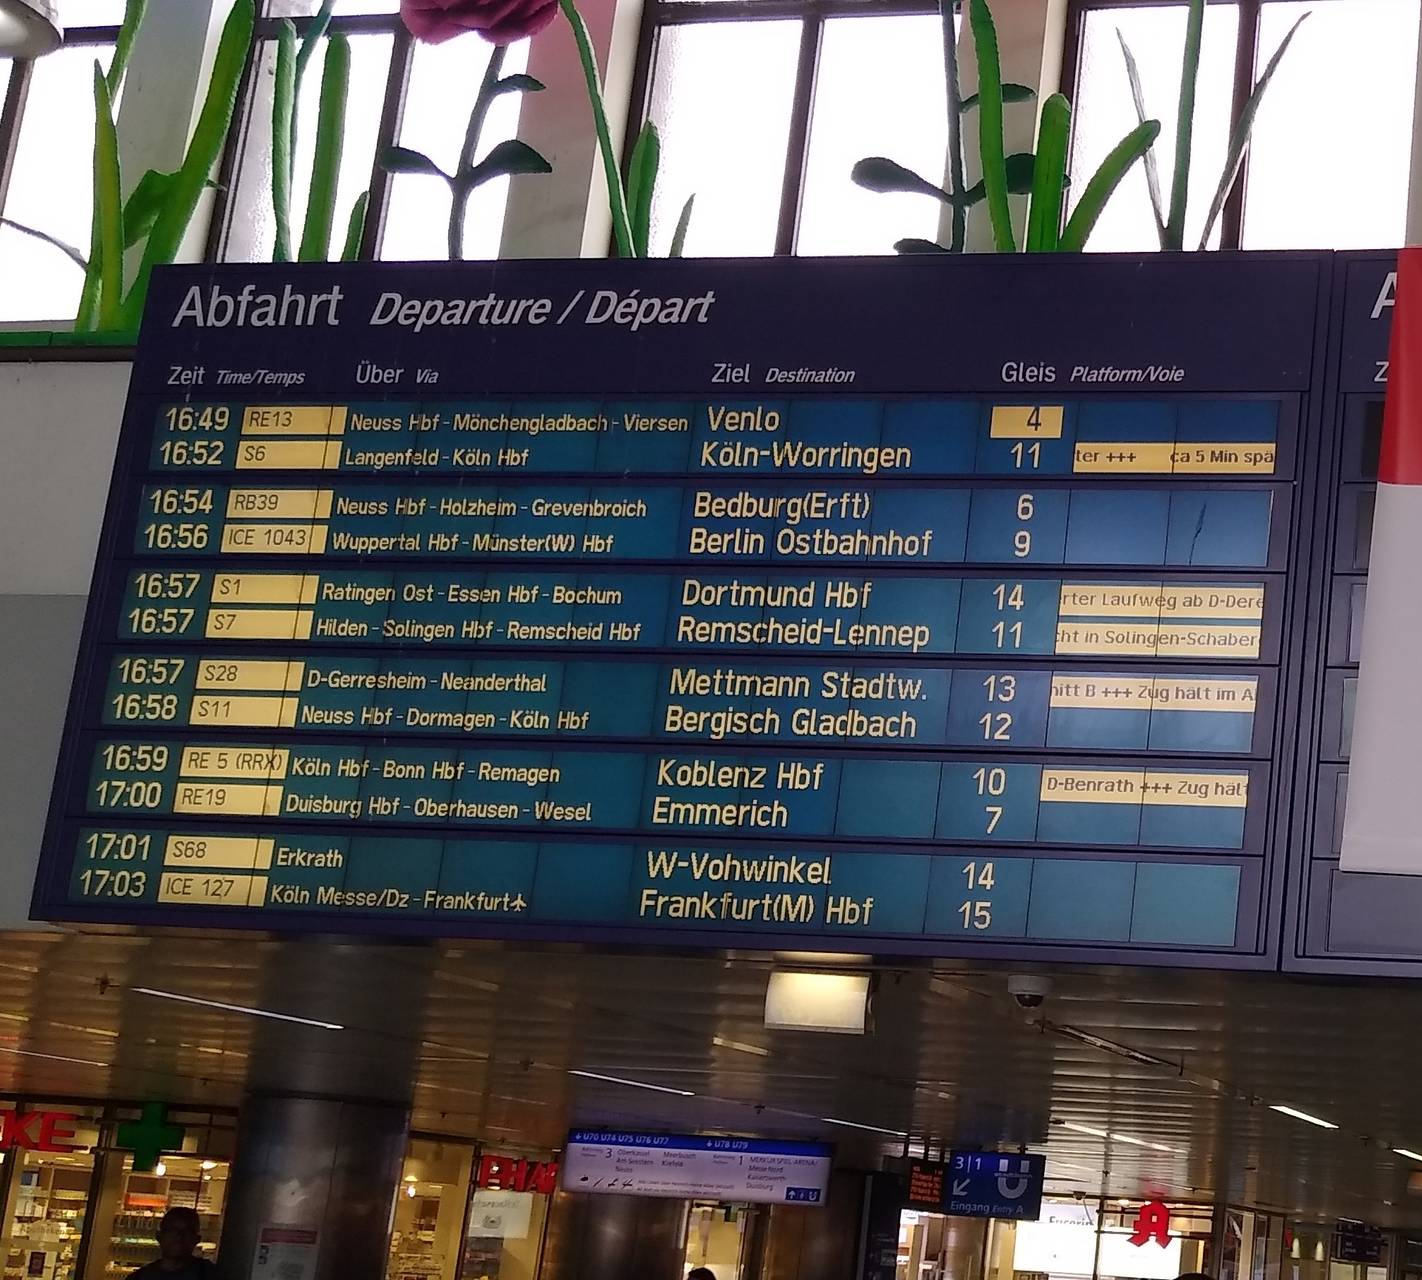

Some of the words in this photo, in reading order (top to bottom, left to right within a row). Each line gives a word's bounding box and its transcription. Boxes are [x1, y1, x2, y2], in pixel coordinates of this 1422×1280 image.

[171, 284, 344, 328] Abfahrt
[369, 292, 552, 333] Departure
[585, 289, 716, 332] Départ
[167, 365, 206, 385] Zeit
[356, 360, 405, 384] Über
[416, 368, 439, 384] Via
[711, 363, 750, 383] Ziel
[765, 367, 856, 383] Destination
[1001, 361, 1056, 383] Gleis
[166, 406, 230, 431] 16:49
[248, 409, 293, 428] RE13
[350, 413, 402, 431] Neuss
[408, 413, 440, 431] Hbf
[453, 413, 608, 436] Mönchengladbach
[623, 413, 688, 432] Viersen
[708, 405, 780, 432] Venlo
[1025, 408, 1043, 433] 4
[159, 440, 225, 465] 16:52
[244, 445, 266, 462] S6
[345, 447, 440, 470] Langenfeld
[452, 448, 491, 466] Köln
[497, 448, 530, 466] Hbf
[700, 441, 911, 474] Köln-Worringen
[1169, 450, 1192, 466] ca
[1194, 448, 1206, 466] 5
[1209, 447, 1240, 466] Min
[233, 493, 279, 511] RB39
[336, 497, 389, 515] Neuss
[395, 497, 427, 516] Hbf
[439, 497, 517, 516] Holzheim
[531, 498, 647, 517] Grevenbroich
[144, 523, 209, 549] 16:56
[228, 528, 256, 546] ICE
[263, 528, 307, 546] 1043
[689, 527, 765, 554] Berlin
[776, 528, 933, 556] Ostbahnhof
[1014, 530, 1031, 557] 9
[135, 573, 201, 598] 16:57
[219, 578, 241, 595] S1
[322, 582, 396, 606] Ratingen
[403, 583, 434, 602] Ost
[447, 584, 501, 603] Essen
[507, 585, 540, 603] Hbf
[552, 585, 622, 604] Bochum
[682, 579, 816, 608] Dortmund
[824, 581, 872, 608] Hbf
[1102, 592, 1177, 611] Laufweg
[1182, 595, 1204, 609] ab
[128, 607, 195, 634] 16:57
[677, 615, 930, 653] Remscheid-Lennep
[119, 658, 185, 684] 16:57
[204, 664, 239, 682] S28
[307, 669, 427, 690] D-Gerresheim
[440, 672, 547, 692] Neanderthal
[669, 668, 810, 698] Mettmann
[821, 671, 927, 700] Stadtw.
[983, 675, 1016, 702] 13
[1138, 685, 1170, 702] Zug
[1174, 685, 1212, 701] hält
[1216, 687, 1236, 701] im
[102, 744, 169, 772] 16:59
[187, 751, 211, 769] RE
[217, 752, 229, 770] 5
[291, 757, 331, 776] Köln
[337, 758, 370, 777] Hbf
[382, 759, 426, 779] Bonn
[431, 760, 465, 780] Hbf
[478, 762, 560, 787] Remagen
[657, 758, 767, 789] Koblenz
[776, 762, 825, 790] Hbf
[1047, 777, 1134, 793] D-Benrath
[1177, 781, 1210, 798] Zug
[1214, 781, 1249, 796] hält
[285, 793, 362, 819] Duisburg
[368, 796, 401, 816] Hbf
[414, 797, 519, 819] Oberhausen
[534, 800, 592, 821] Wesel
[652, 796, 788, 827] Emmerich
[985, 806, 1003, 834] 7
[86, 832, 151, 861] 17:01
[172, 840, 207, 859] S68
[276, 847, 343, 868] Erkrath
[647, 850, 832, 885] W-Vohwinkel
[80, 869, 147, 897] 17:03
[165, 877, 194, 896] ICE
[202, 878, 235, 900] 127
[270, 884, 310, 904] Köln
[826, 895, 874, 925] Hbf
[950, 1200, 991, 1215] Eingang
